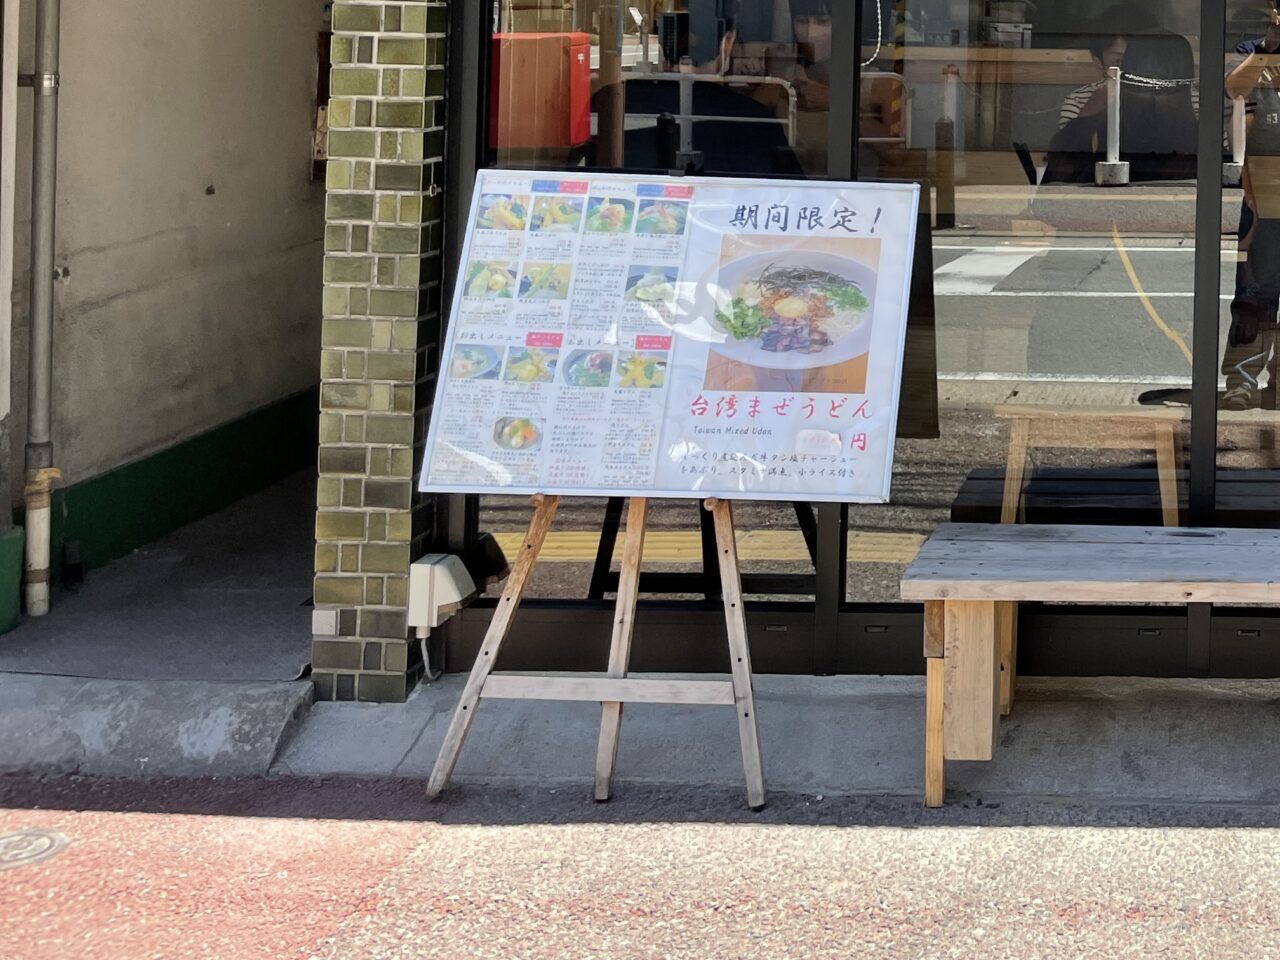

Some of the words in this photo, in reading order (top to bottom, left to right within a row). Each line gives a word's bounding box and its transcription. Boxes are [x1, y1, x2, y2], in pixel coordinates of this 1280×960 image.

[690, 394, 873, 420] 台湾まぜうどん
[694, 425, 722, 435] Taiwan
[725, 426, 749, 436] Mixed
[751, 427, 772, 436] Udon
[850, 432, 868, 452] 円
